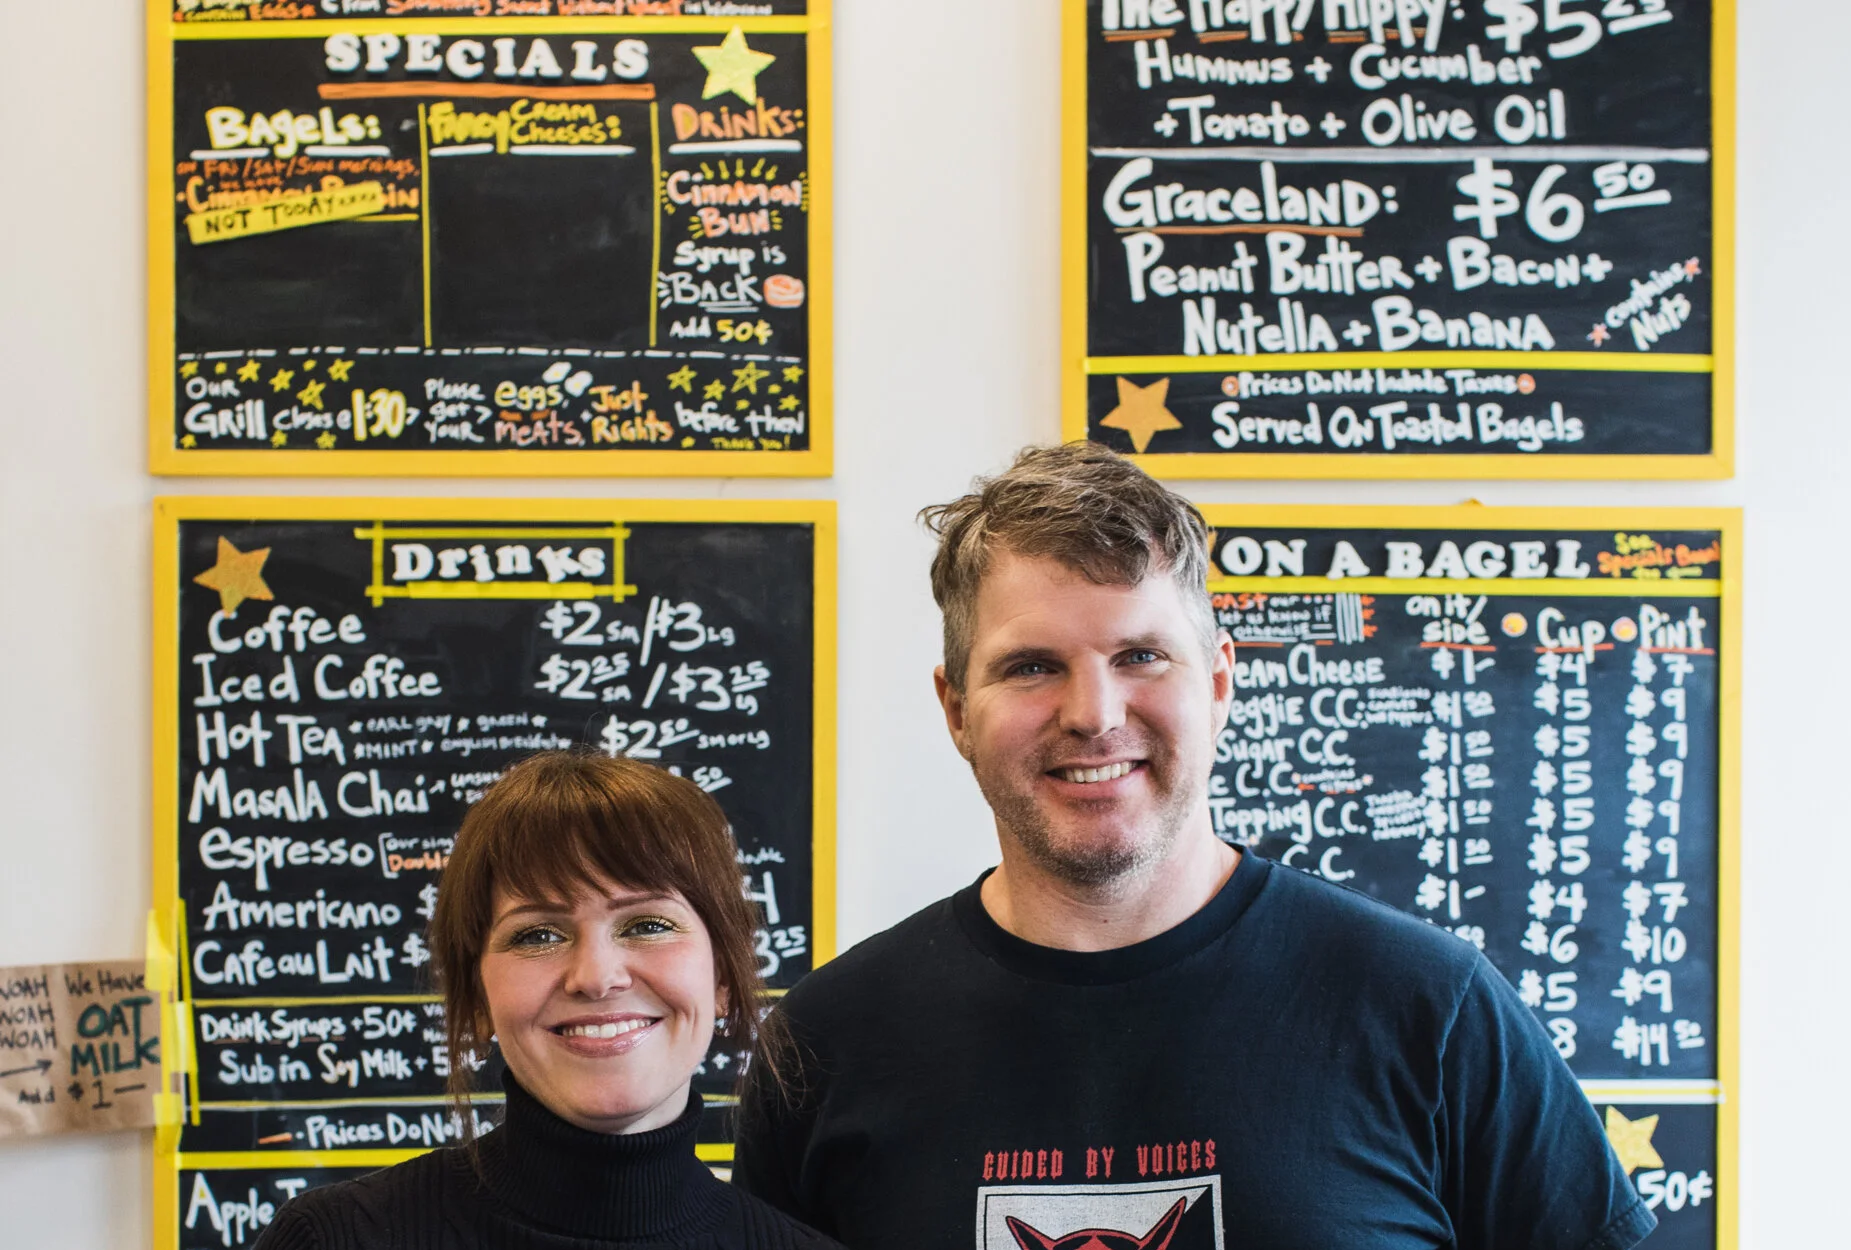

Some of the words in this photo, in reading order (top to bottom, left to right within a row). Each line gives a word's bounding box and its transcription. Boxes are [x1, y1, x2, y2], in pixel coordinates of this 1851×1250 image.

[324, 33, 649, 81] SPECIALS
[1133, 38, 1295, 89] Hummus
[1350, 43, 1543, 91] Cucumber
[1166, 94, 1312, 145] Tomato
[1361, 93, 1478, 147] Olive
[1494, 89, 1567, 145] Oil
[205, 208, 253, 233] NOT
[673, 241, 756, 275] Syrup
[762, 241, 787, 265] is
[1121, 231, 1259, 303] Peanut
[669, 317, 712, 339] Add
[716, 319, 774, 345] 50¢
[1629, 291, 1693, 352] Nuts
[1211, 400, 1324, 450] Served
[1368, 400, 1474, 451] Toasted
[1476, 400, 1585, 453] Bagels
[391, 543, 606, 584] Drinks
[1220, 535, 1308, 577] ON
[1326, 539, 1371, 580] A
[1384, 539, 1591, 580] BAGEL
[207, 605, 367, 654] Coffee
[1536, 606, 1607, 664] Cup
[192, 653, 301, 707] Iced
[313, 653, 443, 701] Coffee
[1535, 649, 1587, 687] $4
[1630, 649, 1695, 688] $7
[1533, 681, 1592, 722] $5
[1624, 683, 1687, 722] $9
[197, 710, 273, 768] Hot
[1533, 723, 1592, 758] $5
[1625, 720, 1689, 761] $9
[337, 768, 430, 818] Chai
[1530, 759, 1593, 797] $5
[1626, 756, 1685, 801] $9
[1207, 797, 1314, 845] Topping
[1524, 796, 1596, 833] $5
[1624, 795, 1681, 836] $9
[1527, 832, 1592, 876] $5
[1621, 829, 1679, 879] $9
[1526, 878, 1589, 924] $4
[1621, 879, 1690, 924] $7
[1520, 920, 1580, 964] $6
[1620, 917, 1688, 965] $10
[64, 970, 92, 997] We
[97, 969, 146, 996] Have
[1518, 968, 1579, 1012] $5
[1610, 966, 1674, 1013] $9
[76, 995, 154, 1039] OAT
[70, 1034, 162, 1078] MILK
[218, 1049, 276, 1086] Sub
[278, 1055, 312, 1083] in
[360, 1050, 413, 1080] Milk
[981, 1147, 1065, 1182] GUIDED
[1085, 1145, 1116, 1180] BY
[1136, 1138, 1218, 1178] VOICES
[184, 1172, 276, 1248] Apple
[1636, 1169, 1714, 1213] 50¢
